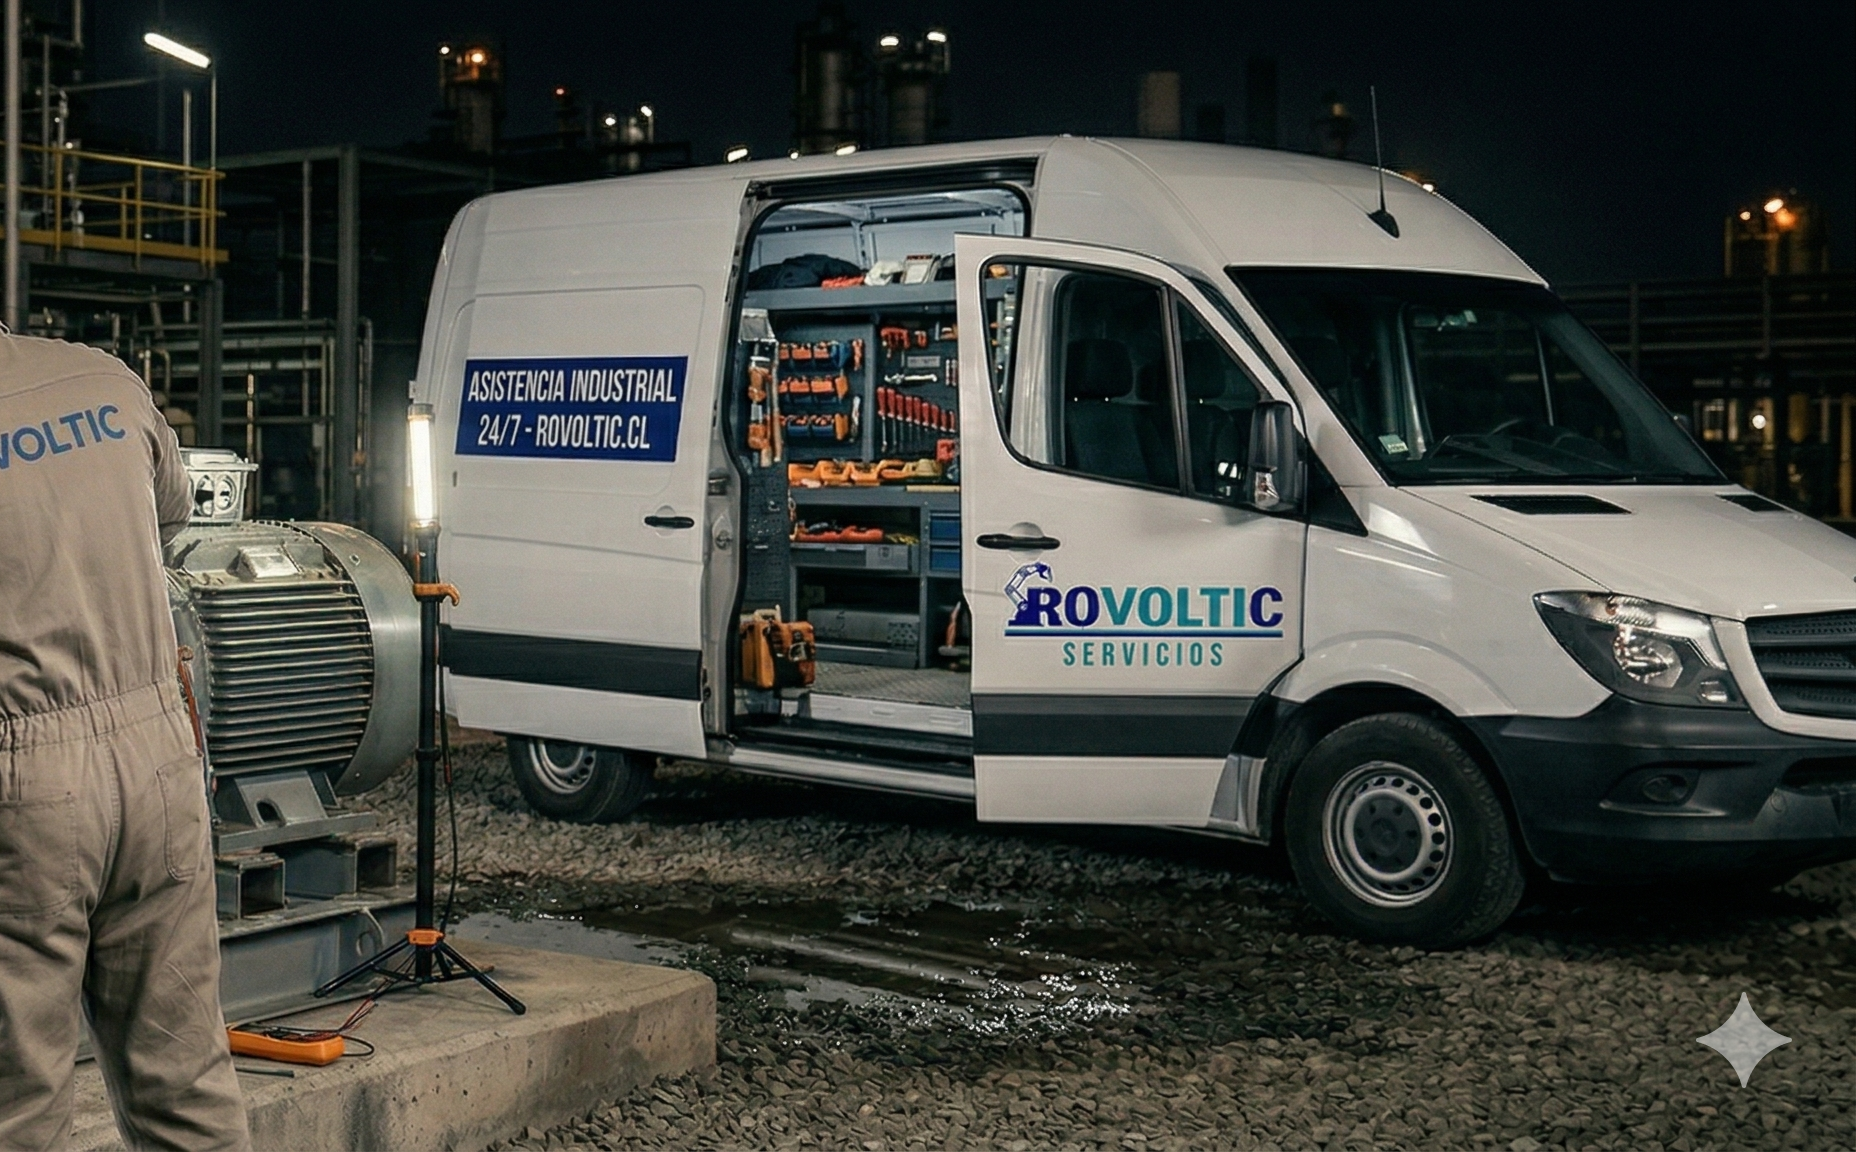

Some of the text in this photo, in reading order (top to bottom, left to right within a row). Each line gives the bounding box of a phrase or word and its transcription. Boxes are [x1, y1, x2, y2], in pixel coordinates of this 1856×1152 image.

[467, 368, 677, 402] ASISTENCIA INDUSTRIAL
[477, 414, 522, 446] 24/7
[535, 414, 651, 449] ROVOLTIC.CL
[1010, 586, 1284, 627] ROVOLTIC
[1062, 641, 1224, 667] SERVICIOS
